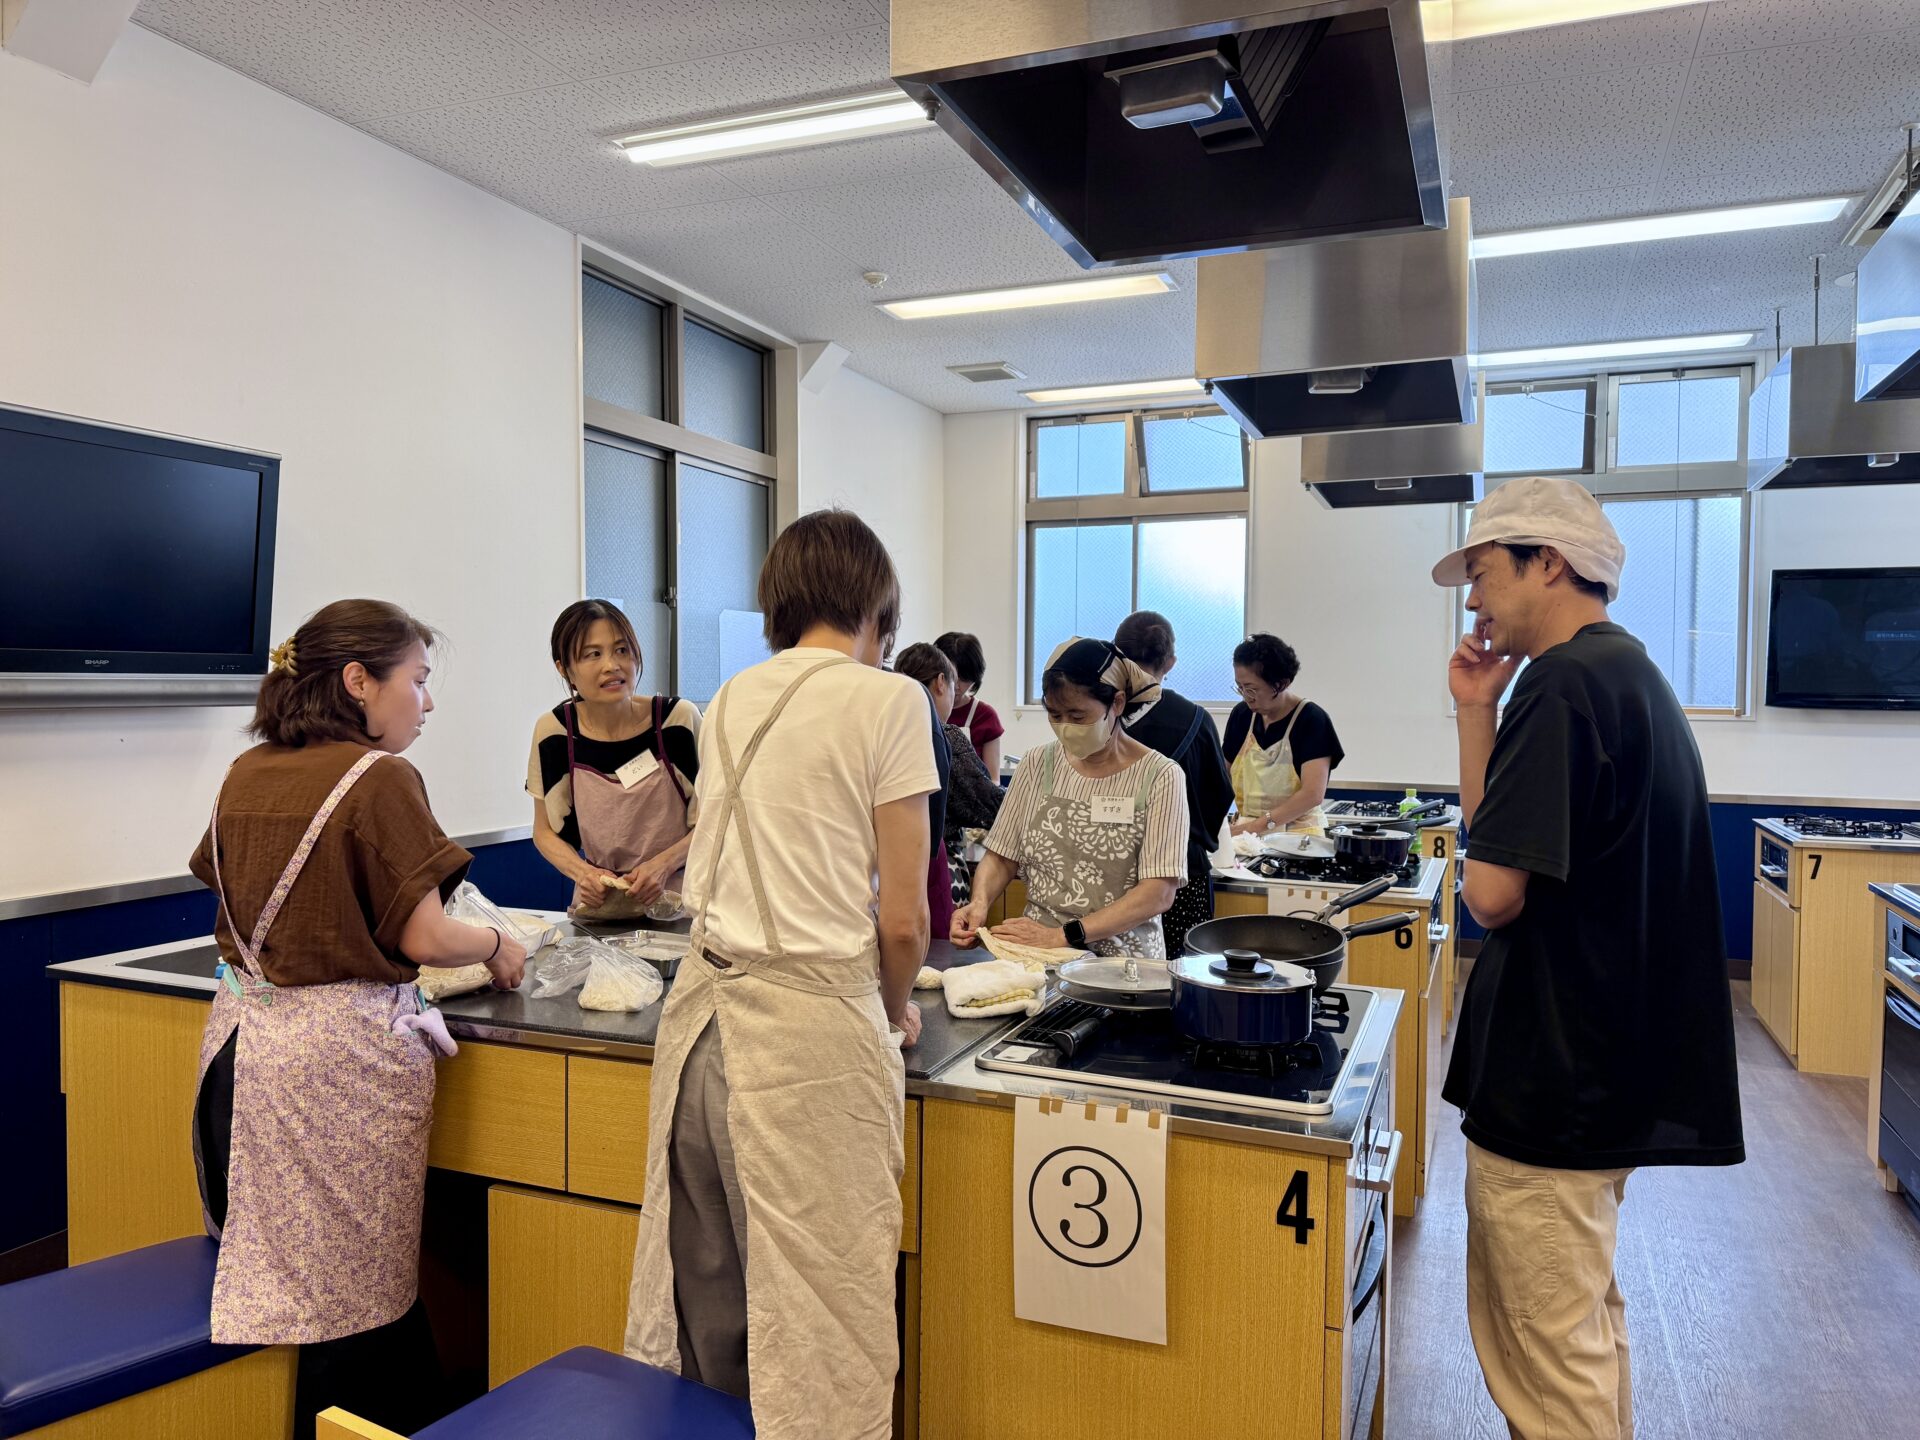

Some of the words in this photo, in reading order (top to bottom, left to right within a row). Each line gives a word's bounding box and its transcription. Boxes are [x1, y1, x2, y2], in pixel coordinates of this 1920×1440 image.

[1433, 836, 1446, 858] 8
[1808, 854, 1822, 879] 7
[1394, 922, 1413, 950] 6
[1276, 1169, 1315, 1245] 4
